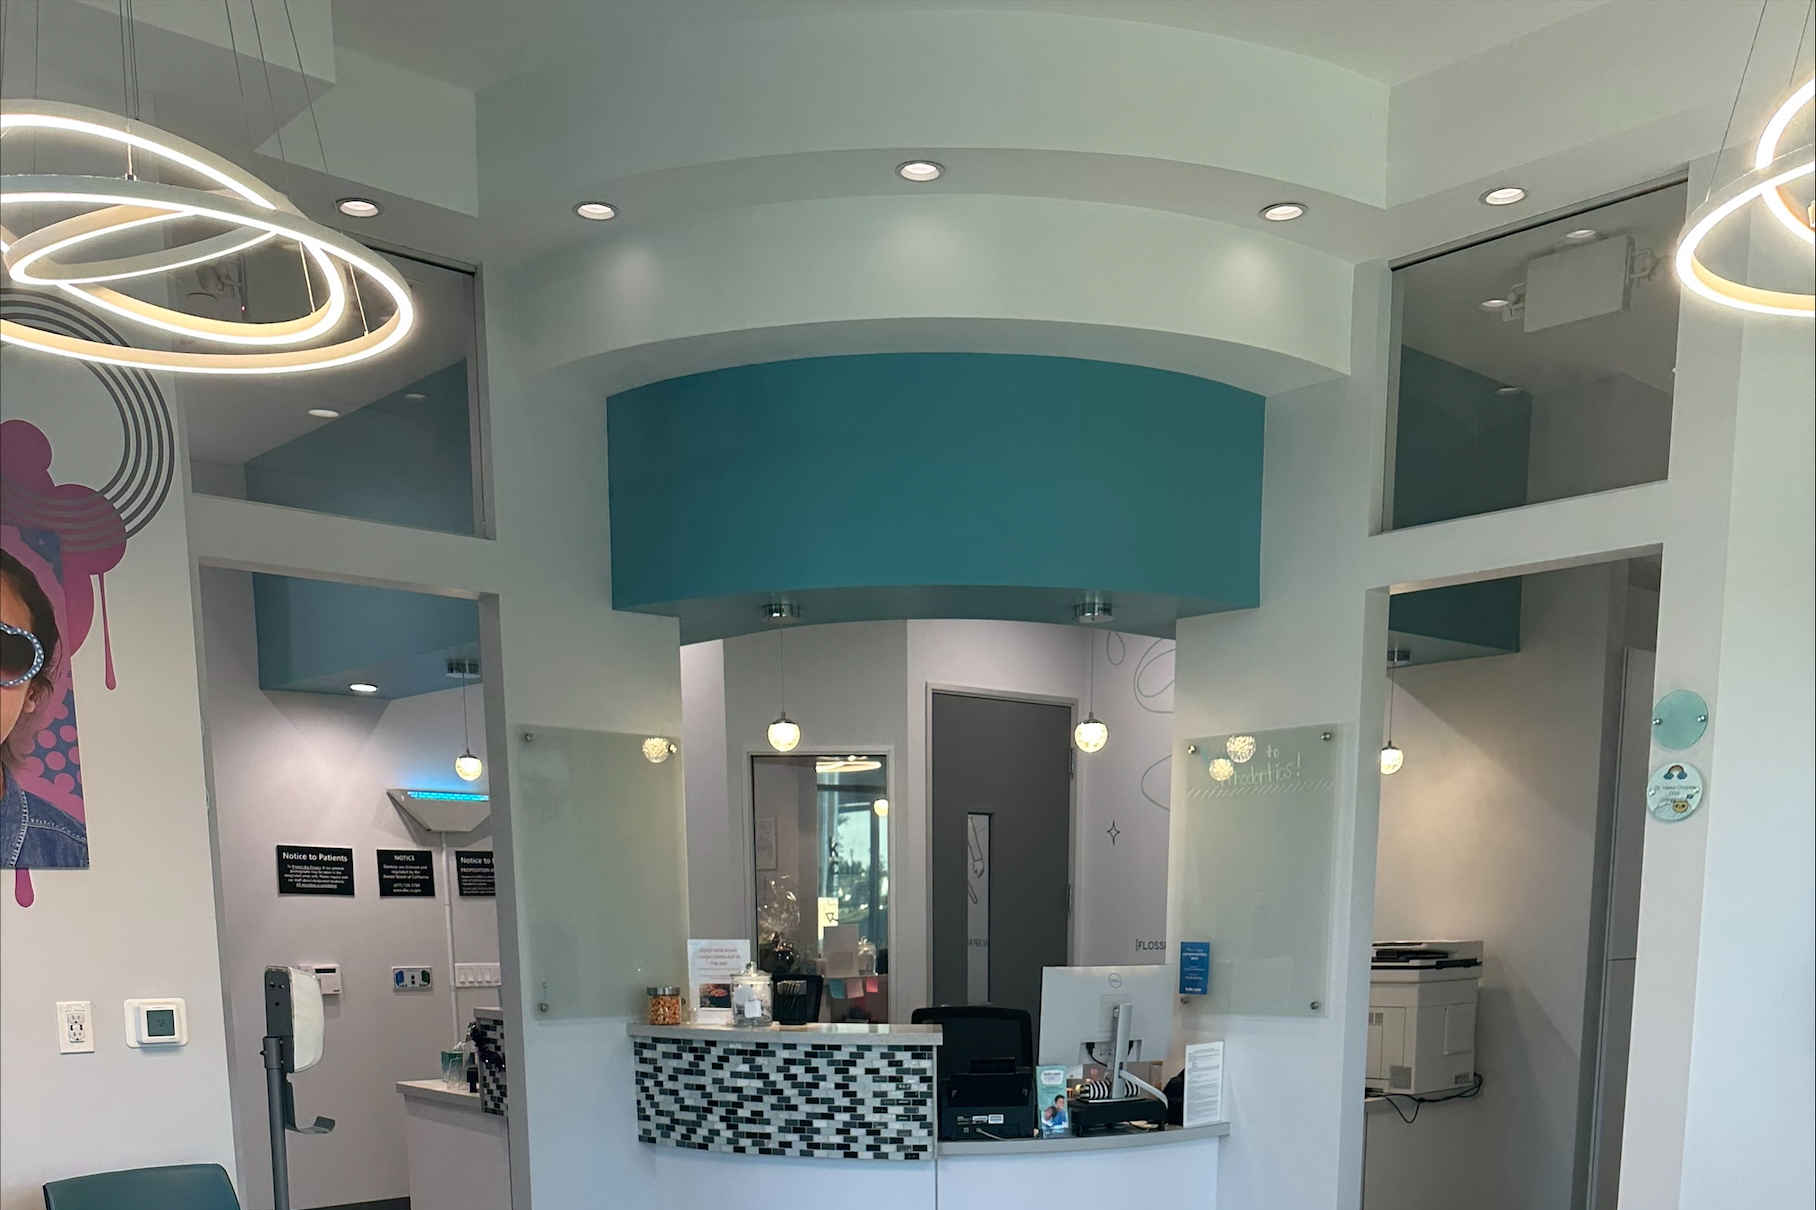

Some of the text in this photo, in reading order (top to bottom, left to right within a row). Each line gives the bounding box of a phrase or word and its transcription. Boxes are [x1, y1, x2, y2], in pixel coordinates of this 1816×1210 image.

[1265, 744, 1281, 759] to
[282, 851, 349, 863] Notice to Patients
[394, 854, 416, 862] NOTICE
[460, 856, 482, 864] Notice
